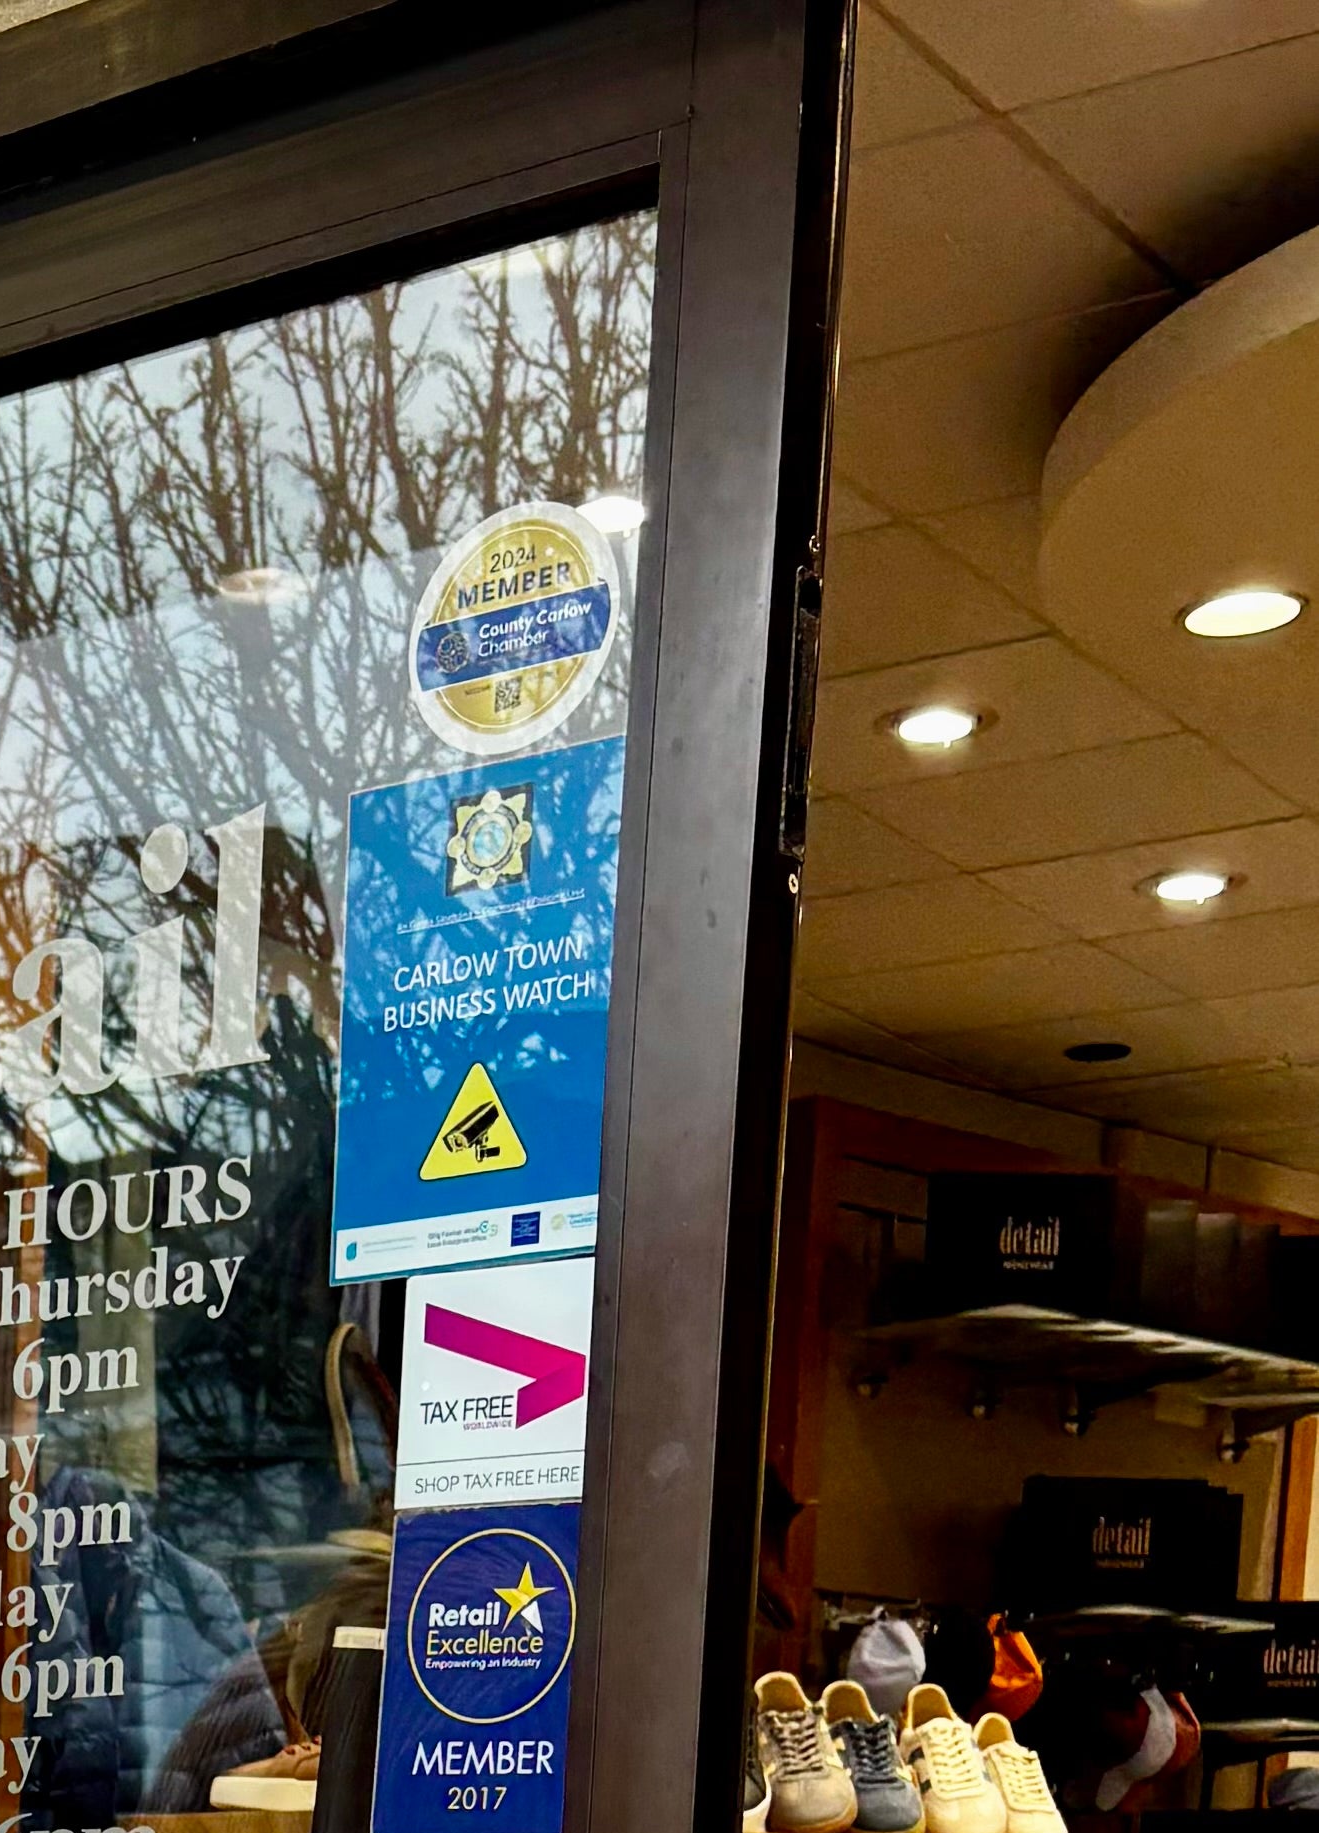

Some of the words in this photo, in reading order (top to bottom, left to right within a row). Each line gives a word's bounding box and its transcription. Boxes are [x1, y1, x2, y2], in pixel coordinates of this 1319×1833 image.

[490, 544, 537, 573] 2024
[458, 562, 571, 609] MEMBER
[479, 616, 534, 639] County
[536, 602, 592, 625] Carlow
[478, 630, 549, 657] Chamber
[393, 949, 499, 993] CARLOW
[503, 936, 584, 972] TOWN
[383, 988, 496, 1032] BUSINESS
[503, 971, 591, 1010] WATCH
[3, 1157, 252, 1252] HOURS
[999, 1216, 1060, 1256] detail
[12, 1338, 140, 1414] 6pm
[420, 1400, 459, 1425] TAX
[463, 1395, 514, 1421] FREE
[414, 1475, 460, 1494] SHOP
[463, 1472, 494, 1490] TAX
[495, 1469, 535, 1488] FREE
[537, 1465, 581, 1484] HERE
[6, 1491, 133, 1567] 8pm
[428, 1601, 501, 1628] Retail
[426, 1629, 544, 1656] Excellence
[1, 1642, 125, 1717] 6pm
[425, 1657, 487, 1671] Empowering
[487, 1659, 501, 1668] an
[501, 1657, 541, 1670] Industry
[412, 1740, 555, 1776] MEMBER
[447, 1786, 508, 1811] 2017
